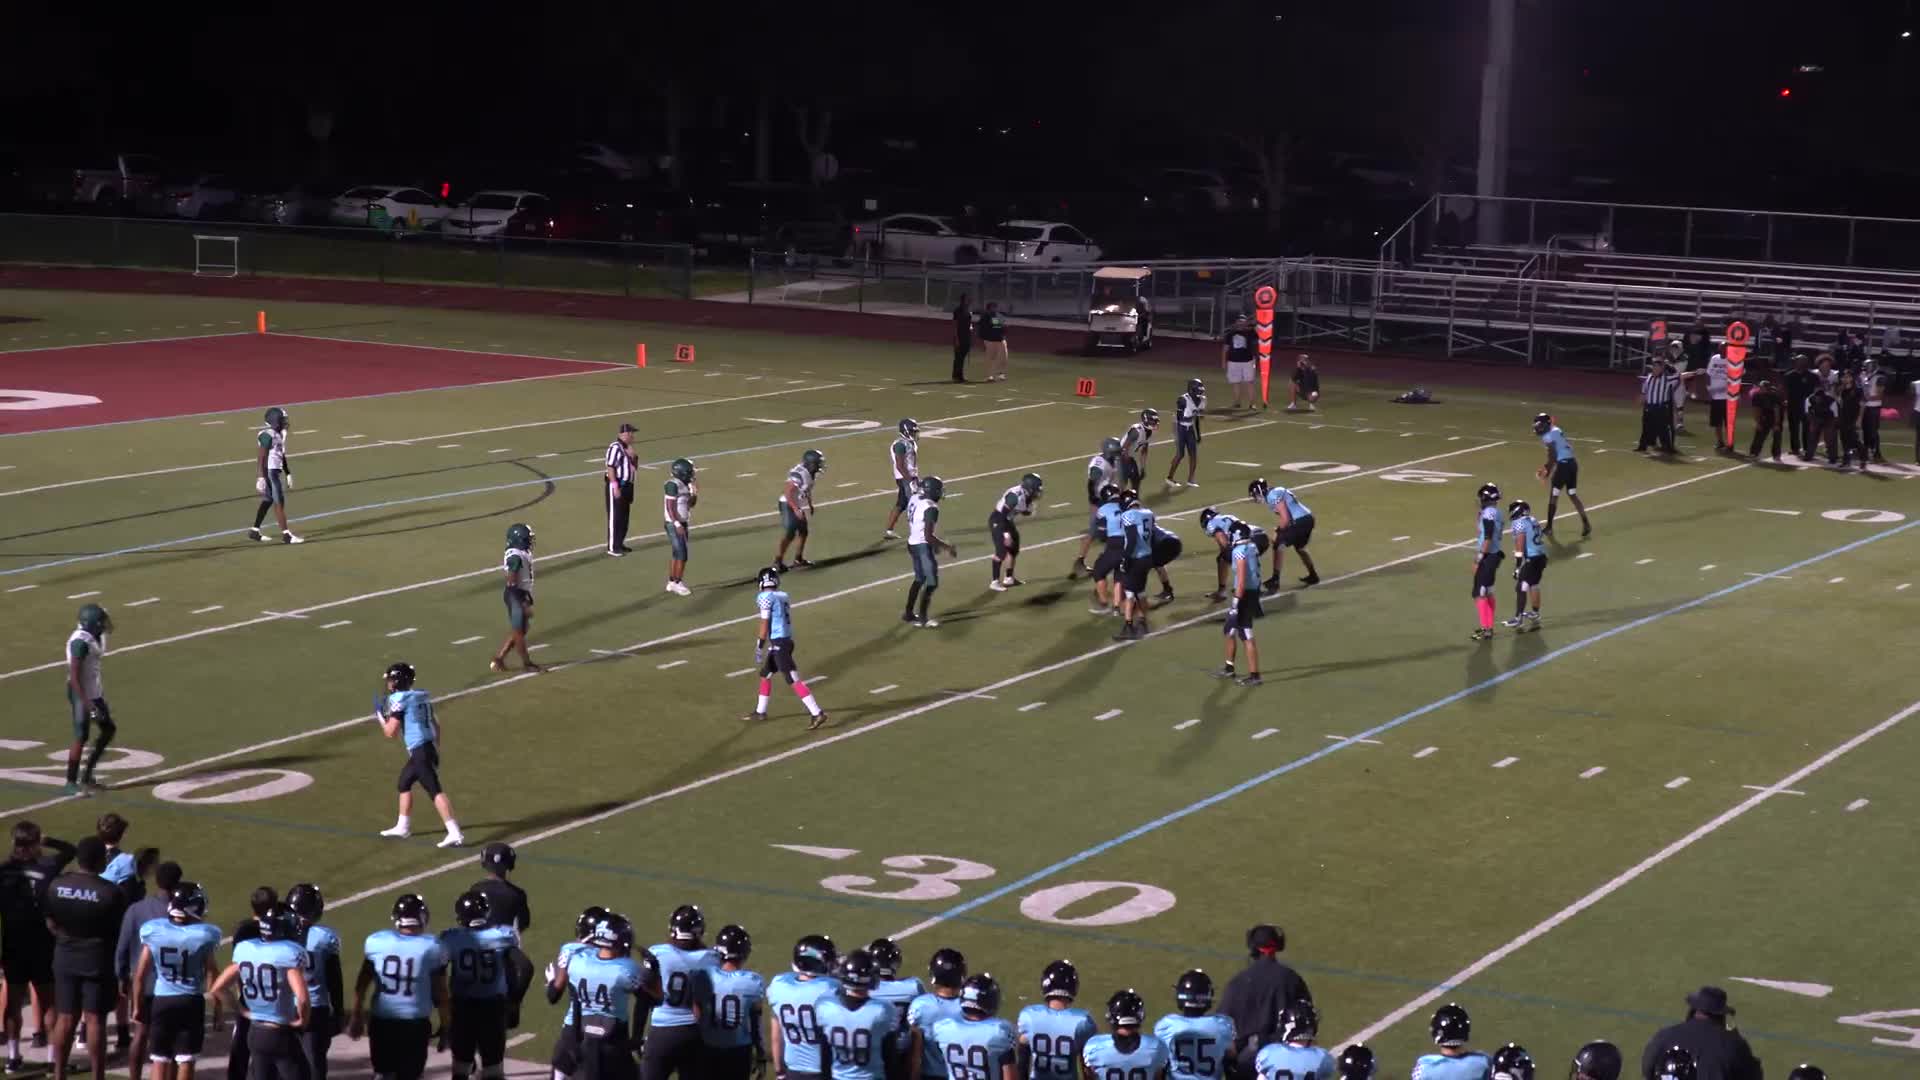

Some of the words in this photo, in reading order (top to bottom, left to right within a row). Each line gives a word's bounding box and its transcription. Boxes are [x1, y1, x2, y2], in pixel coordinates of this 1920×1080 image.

[1080, 380, 1093, 393] 10
[57, 887, 98, 902] TEAM
[819, 854, 1177, 927] 30
[160, 947, 194, 985] 51
[382, 955, 415, 997] 91
[577, 978, 612, 1013] 44
[780, 1003, 818, 1045] 60
[946, 1043, 989, 1080] 69
[1174, 1038, 1216, 1077] 55
